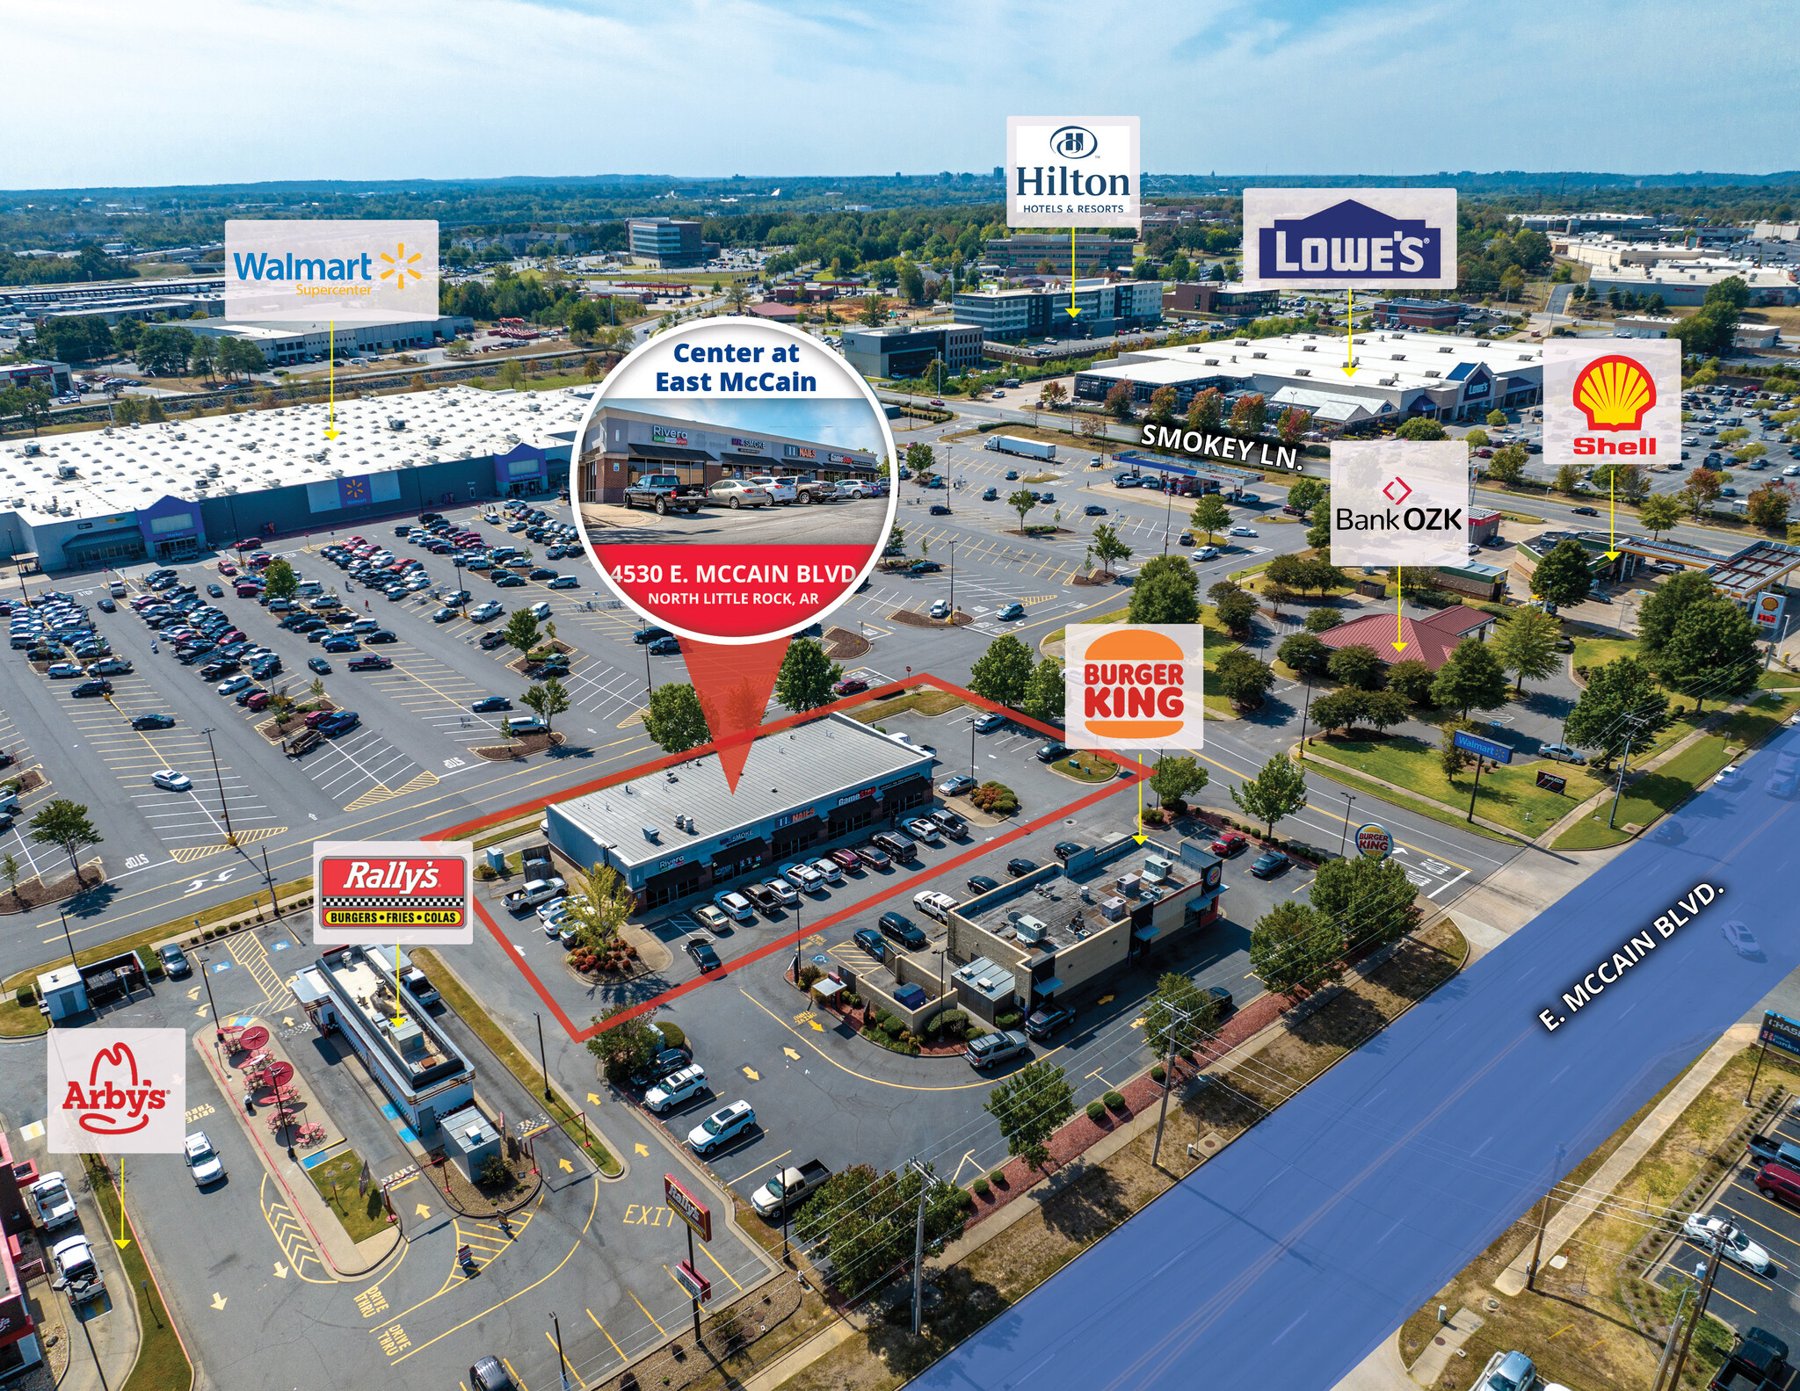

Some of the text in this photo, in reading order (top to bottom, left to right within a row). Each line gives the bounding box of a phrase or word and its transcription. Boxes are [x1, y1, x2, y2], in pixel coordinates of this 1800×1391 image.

[653, 425, 688, 439] Rivera
[1459, 736, 1494, 756] Walmart
[1359, 832, 1389, 842] BURGER
[1359, 840, 1389, 851] KING
[124, 853, 150, 869] STOP
[187, 1106, 216, 1124] DRIVE
[668, 1184, 700, 1222] Rally's
[623, 1204, 676, 1228] EXIT
[354, 1294, 377, 1318] THRU
[367, 1286, 390, 1313] DRIVE
[377, 1330, 399, 1356] THRU
[388, 1323, 412, 1351] DRIVE
